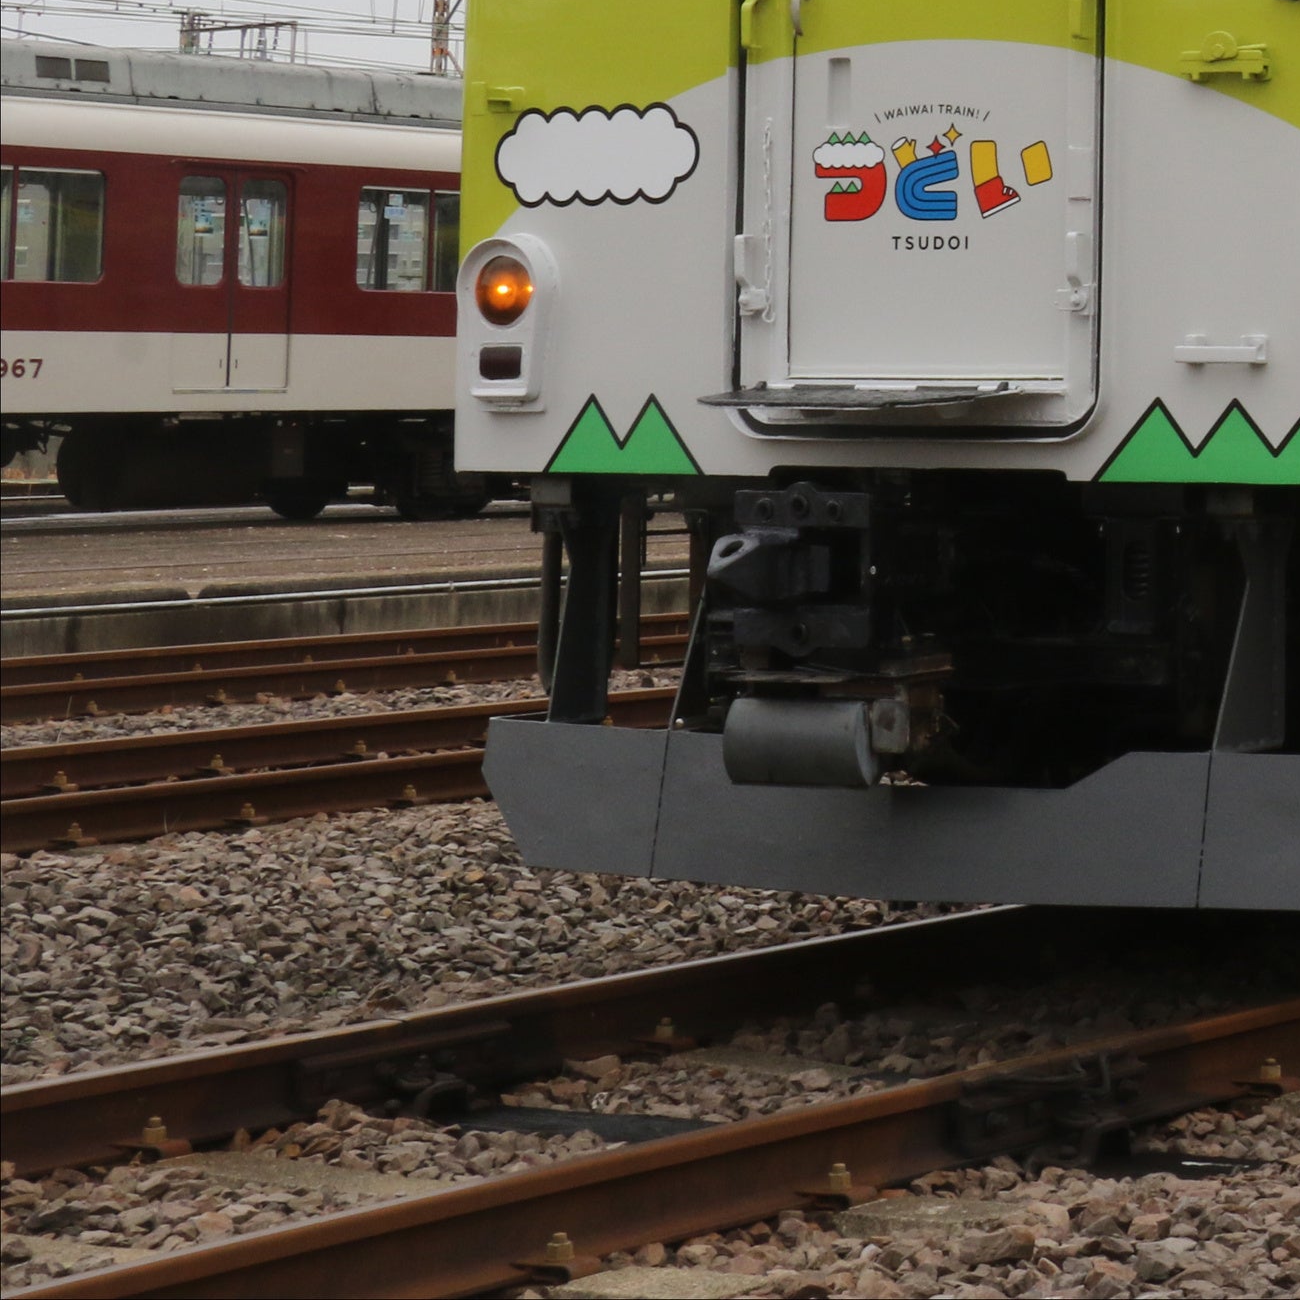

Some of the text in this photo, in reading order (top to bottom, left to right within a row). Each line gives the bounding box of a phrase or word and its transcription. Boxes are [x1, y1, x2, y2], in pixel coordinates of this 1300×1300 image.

[884, 104, 980, 120] WAIWAI TRAIN!
[891, 235, 970, 250] TSUDOI
